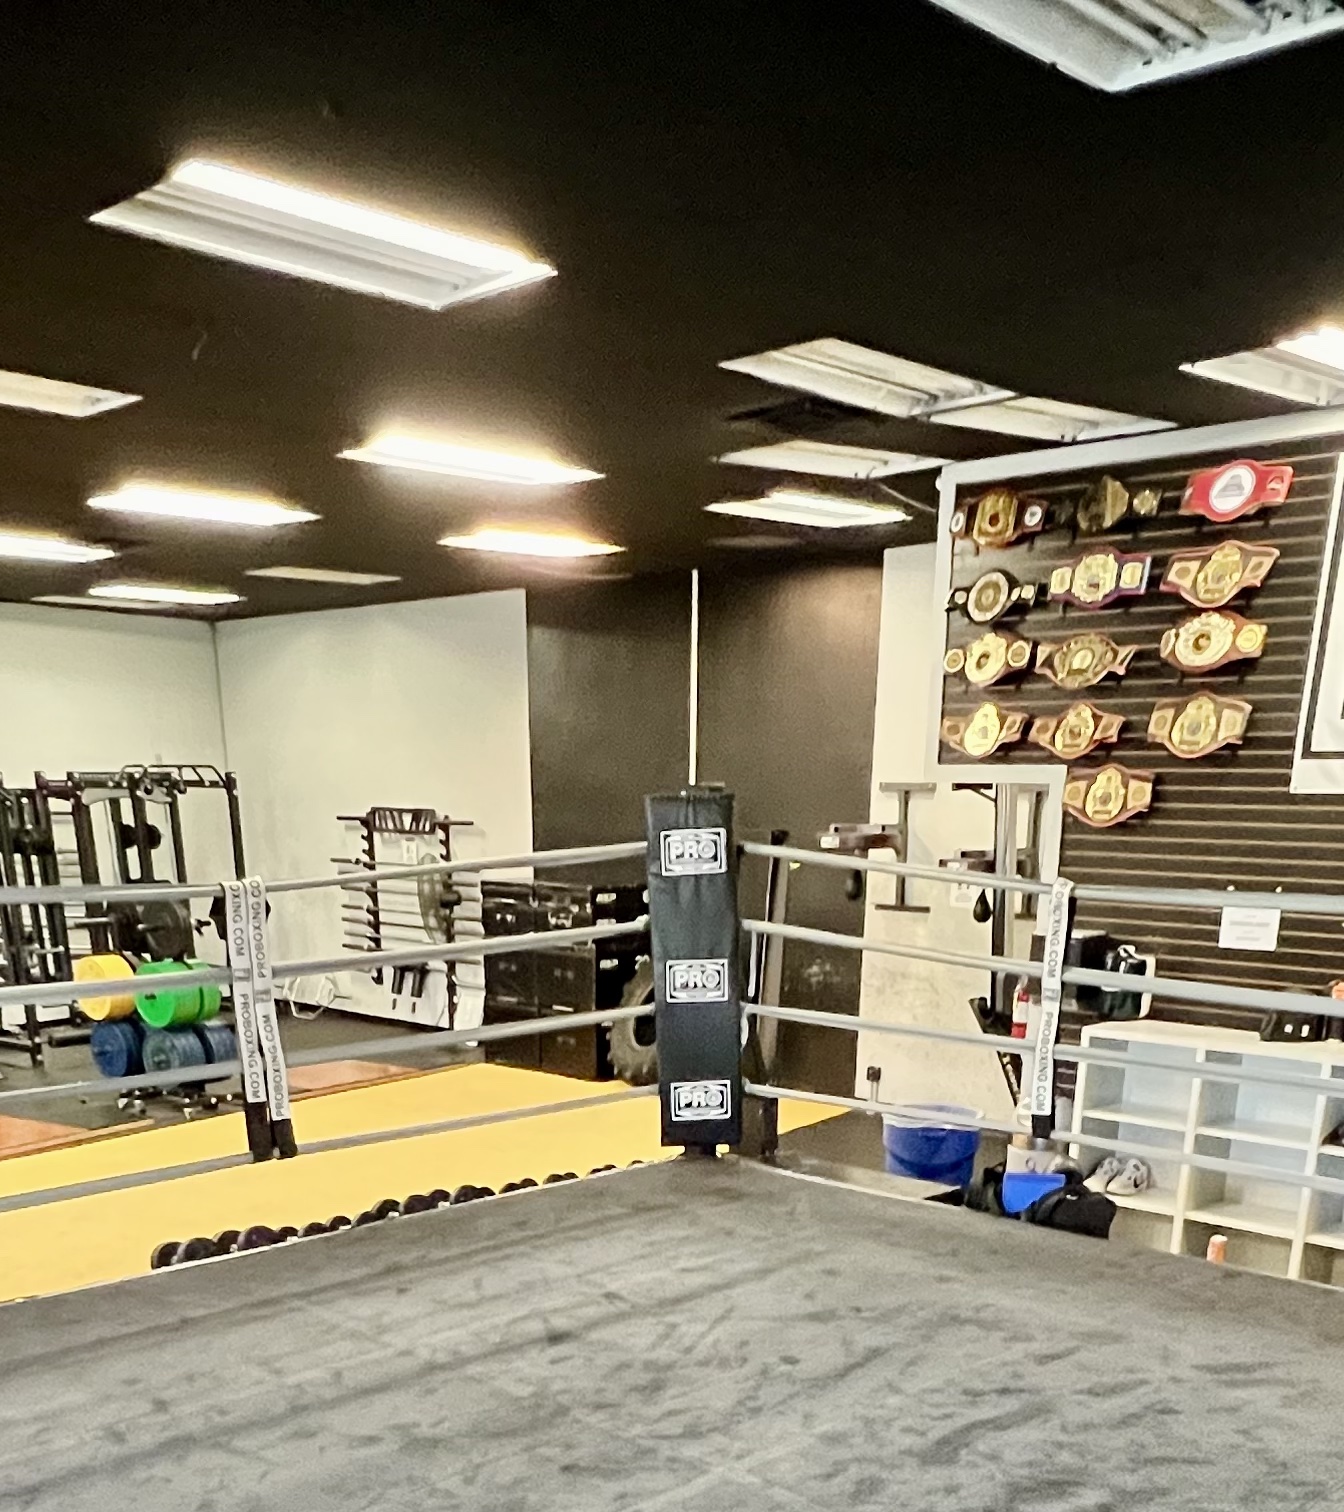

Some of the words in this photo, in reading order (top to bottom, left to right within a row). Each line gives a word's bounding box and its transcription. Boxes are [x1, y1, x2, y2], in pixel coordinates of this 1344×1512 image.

[669, 840, 716, 859] PRO
[674, 970, 720, 989] PRO
[679, 1091, 723, 1108] PRO
